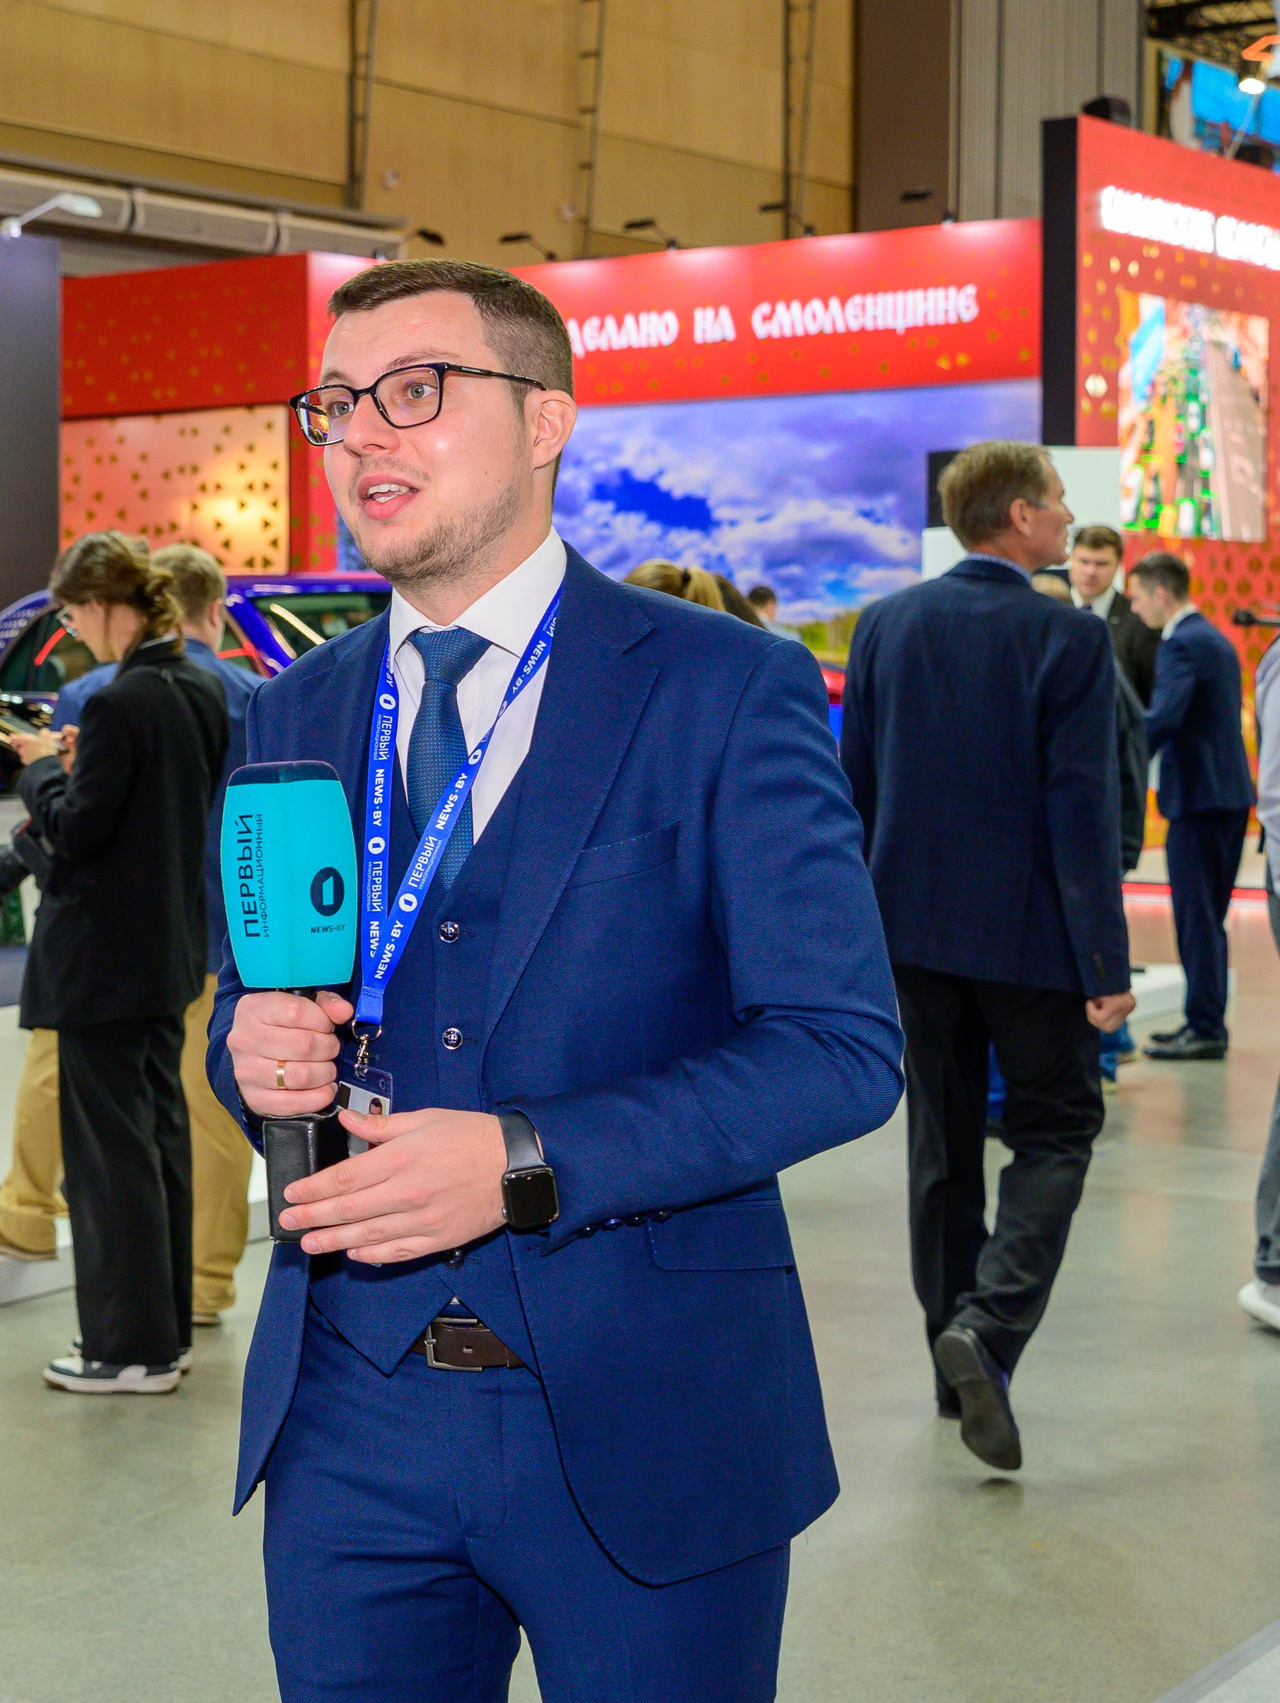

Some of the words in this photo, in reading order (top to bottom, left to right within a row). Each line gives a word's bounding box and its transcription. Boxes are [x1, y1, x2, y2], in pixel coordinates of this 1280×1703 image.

[693, 304, 737, 345] НА
[751, 283, 980, 339] СМОЛЕНЩИНЕ
[378, 715, 394, 761] ПЕРВЫЙ
[234, 814, 261, 938] ПЕРВЫЙ
[255, 813, 270, 938] ИНФОРМАЦИОННЫЙ
[372, 860, 384, 912] ПЕРВЫЙ
[408, 835, 438, 888] ПЕРВЫЙ
